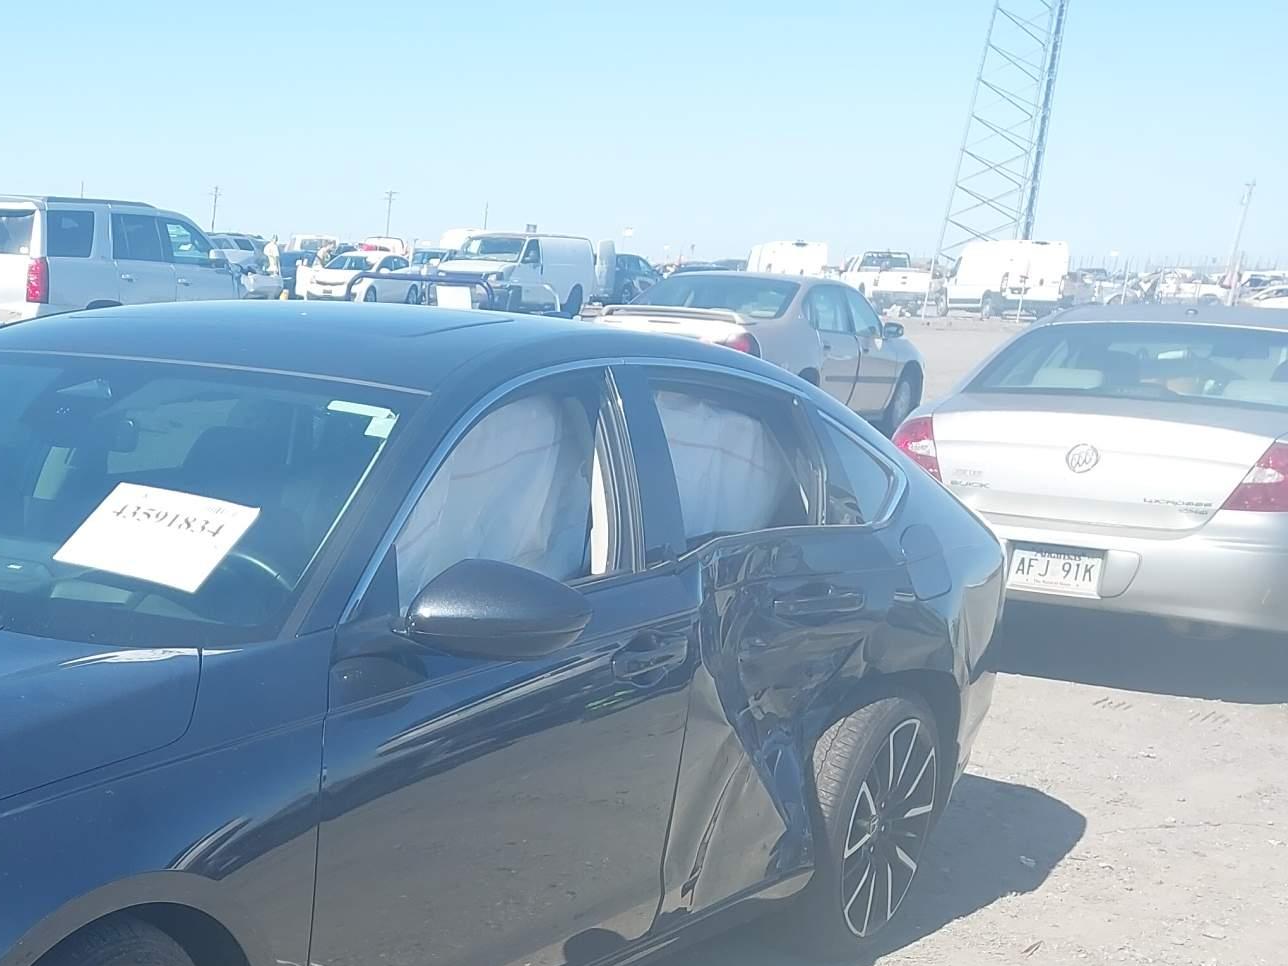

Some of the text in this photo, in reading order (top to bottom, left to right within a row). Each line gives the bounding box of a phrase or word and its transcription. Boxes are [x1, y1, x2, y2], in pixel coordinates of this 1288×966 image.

[112, 503, 225, 538] 43591834
[1015, 556, 1095, 583] AFJ 91K
